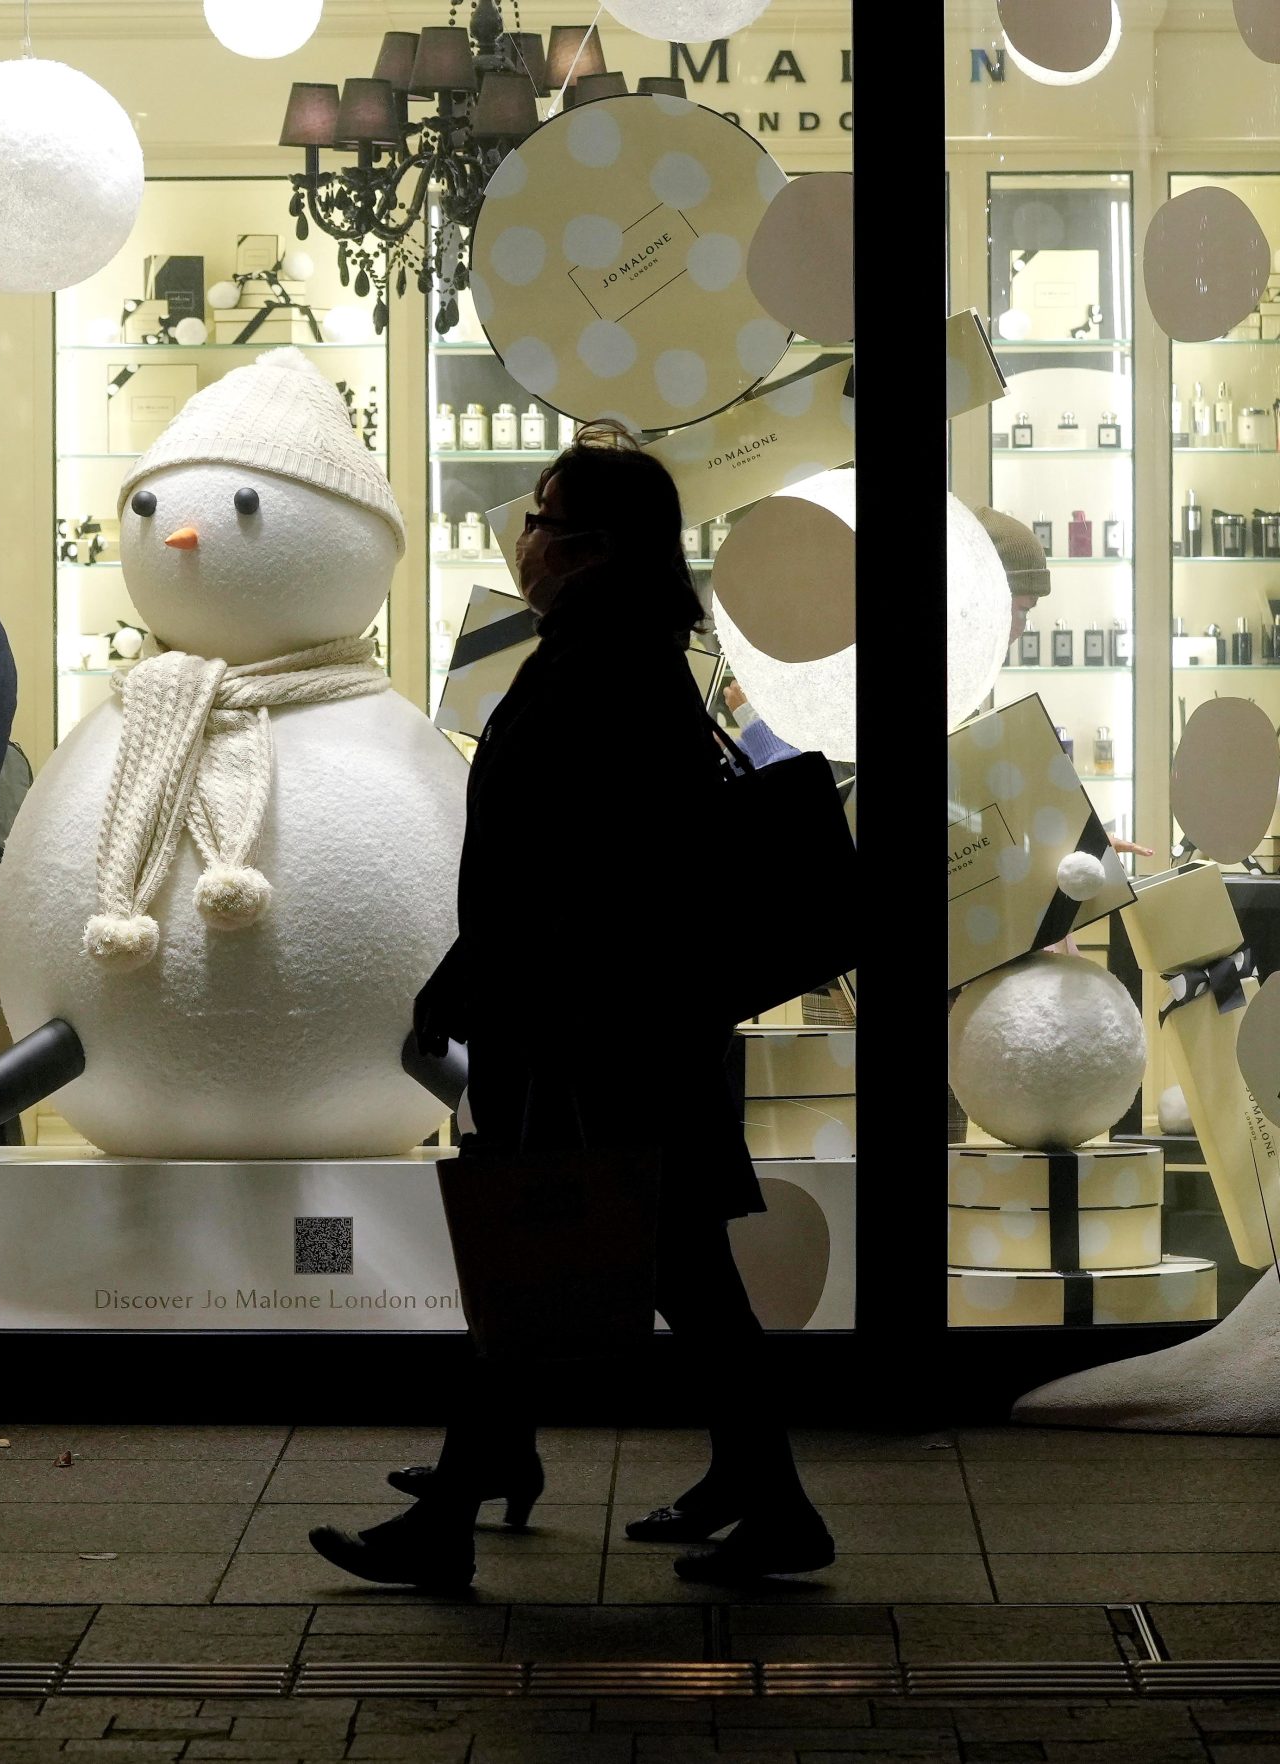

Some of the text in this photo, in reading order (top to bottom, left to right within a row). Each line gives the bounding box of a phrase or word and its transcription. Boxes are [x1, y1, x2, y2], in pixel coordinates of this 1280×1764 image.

[602, 233, 672, 288] JO MALONE
[629, 258, 658, 281] LONDON
[707, 433, 778, 469] JO MALONE
[732, 453, 761, 469] LONDON
[948, 837, 991, 864] ALONE
[948, 859, 974, 876] ONDON
[1244, 1111, 1257, 1141] LONDON
[1252, 1105, 1276, 1158] MALONE
[94, 1289, 193, 1310] Discover
[201, 1289, 227, 1310] Jo
[236, 1288, 321, 1310] Malone
[329, 1288, 417, 1310] London
